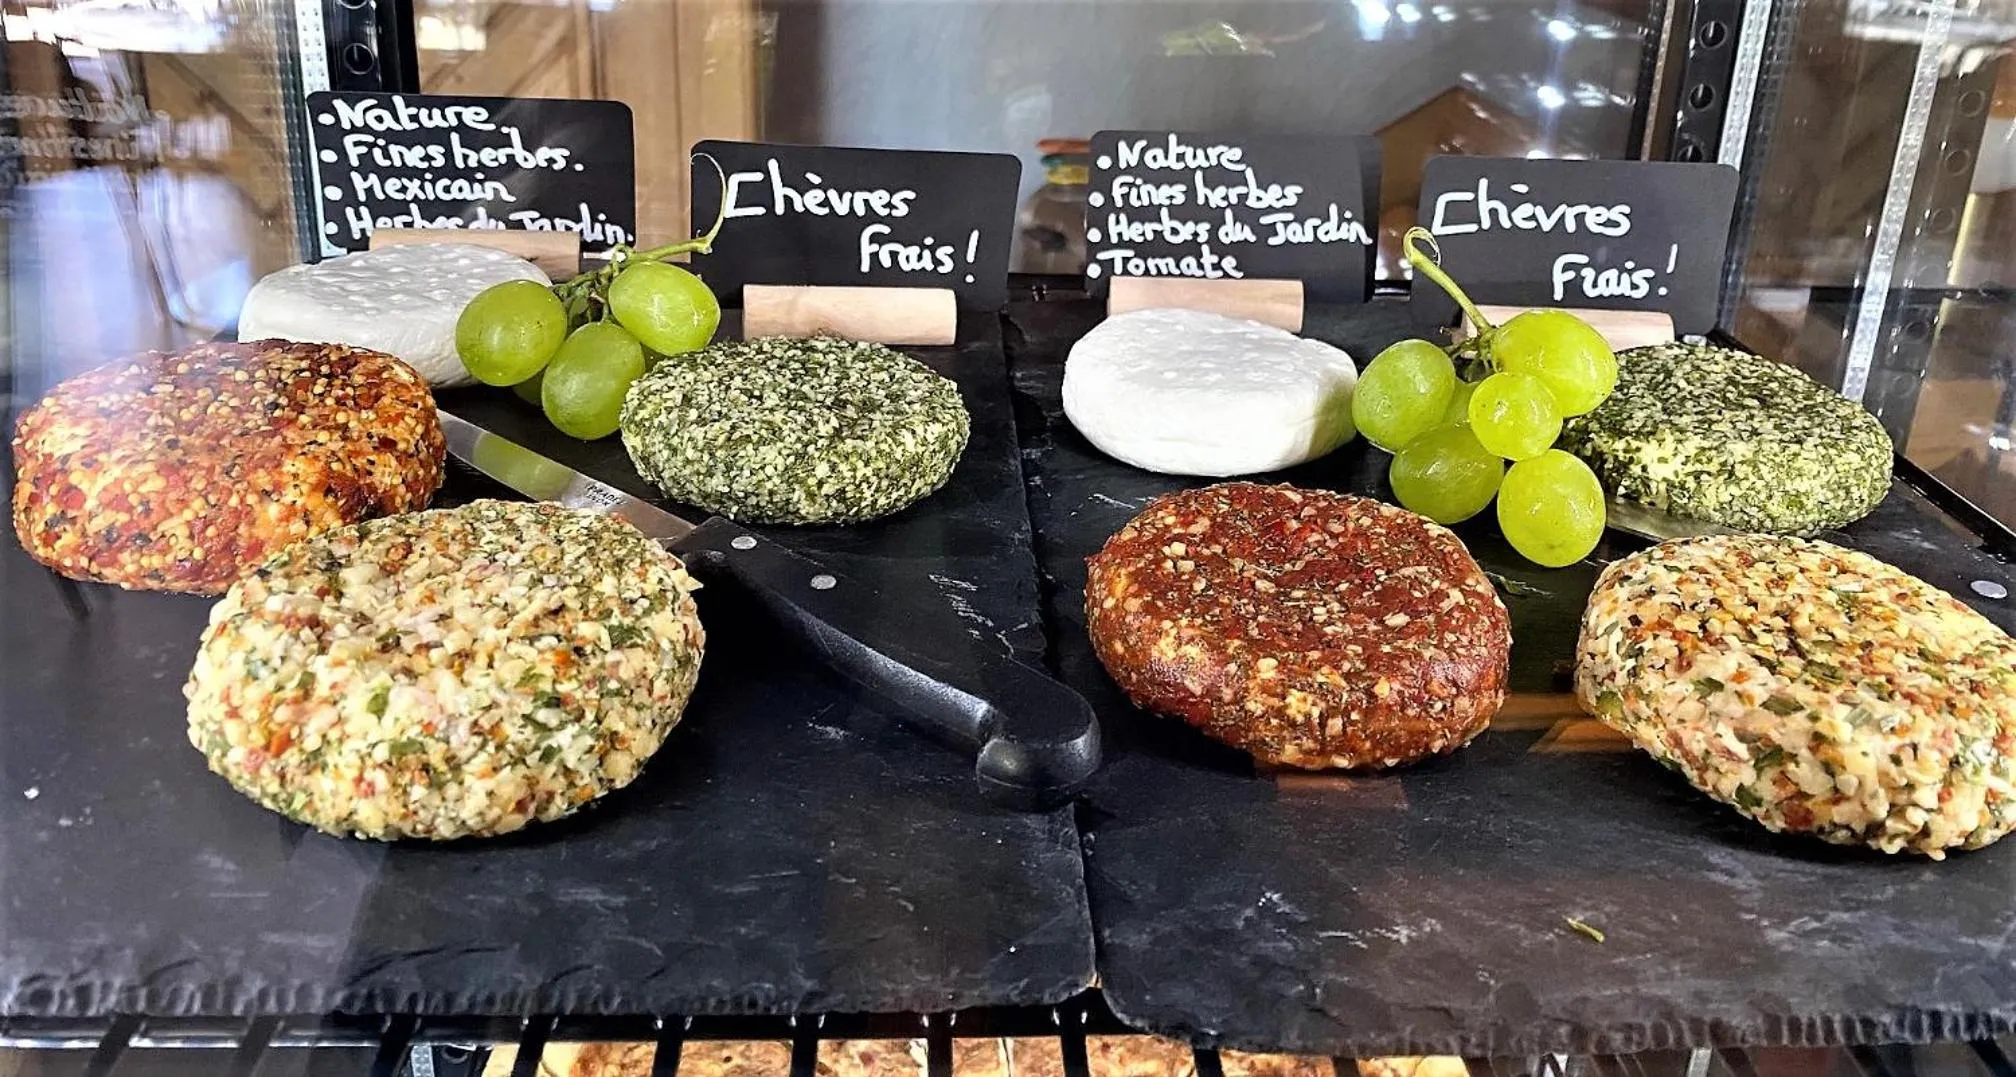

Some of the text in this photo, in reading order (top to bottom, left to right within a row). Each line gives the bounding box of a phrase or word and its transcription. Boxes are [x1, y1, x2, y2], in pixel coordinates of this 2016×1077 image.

[342, 133, 446, 169] Fines
[1117, 132, 1247, 171] Nature
[350, 170, 517, 203] Mexicain
[724, 158, 917, 218] Chèvres
[1194, 166, 1304, 210] herbes
[1431, 177, 1632, 237] Chèvres
[1107, 202, 1374, 246] Herbes du Jardin
[1096, 243, 1245, 279] Tomate
